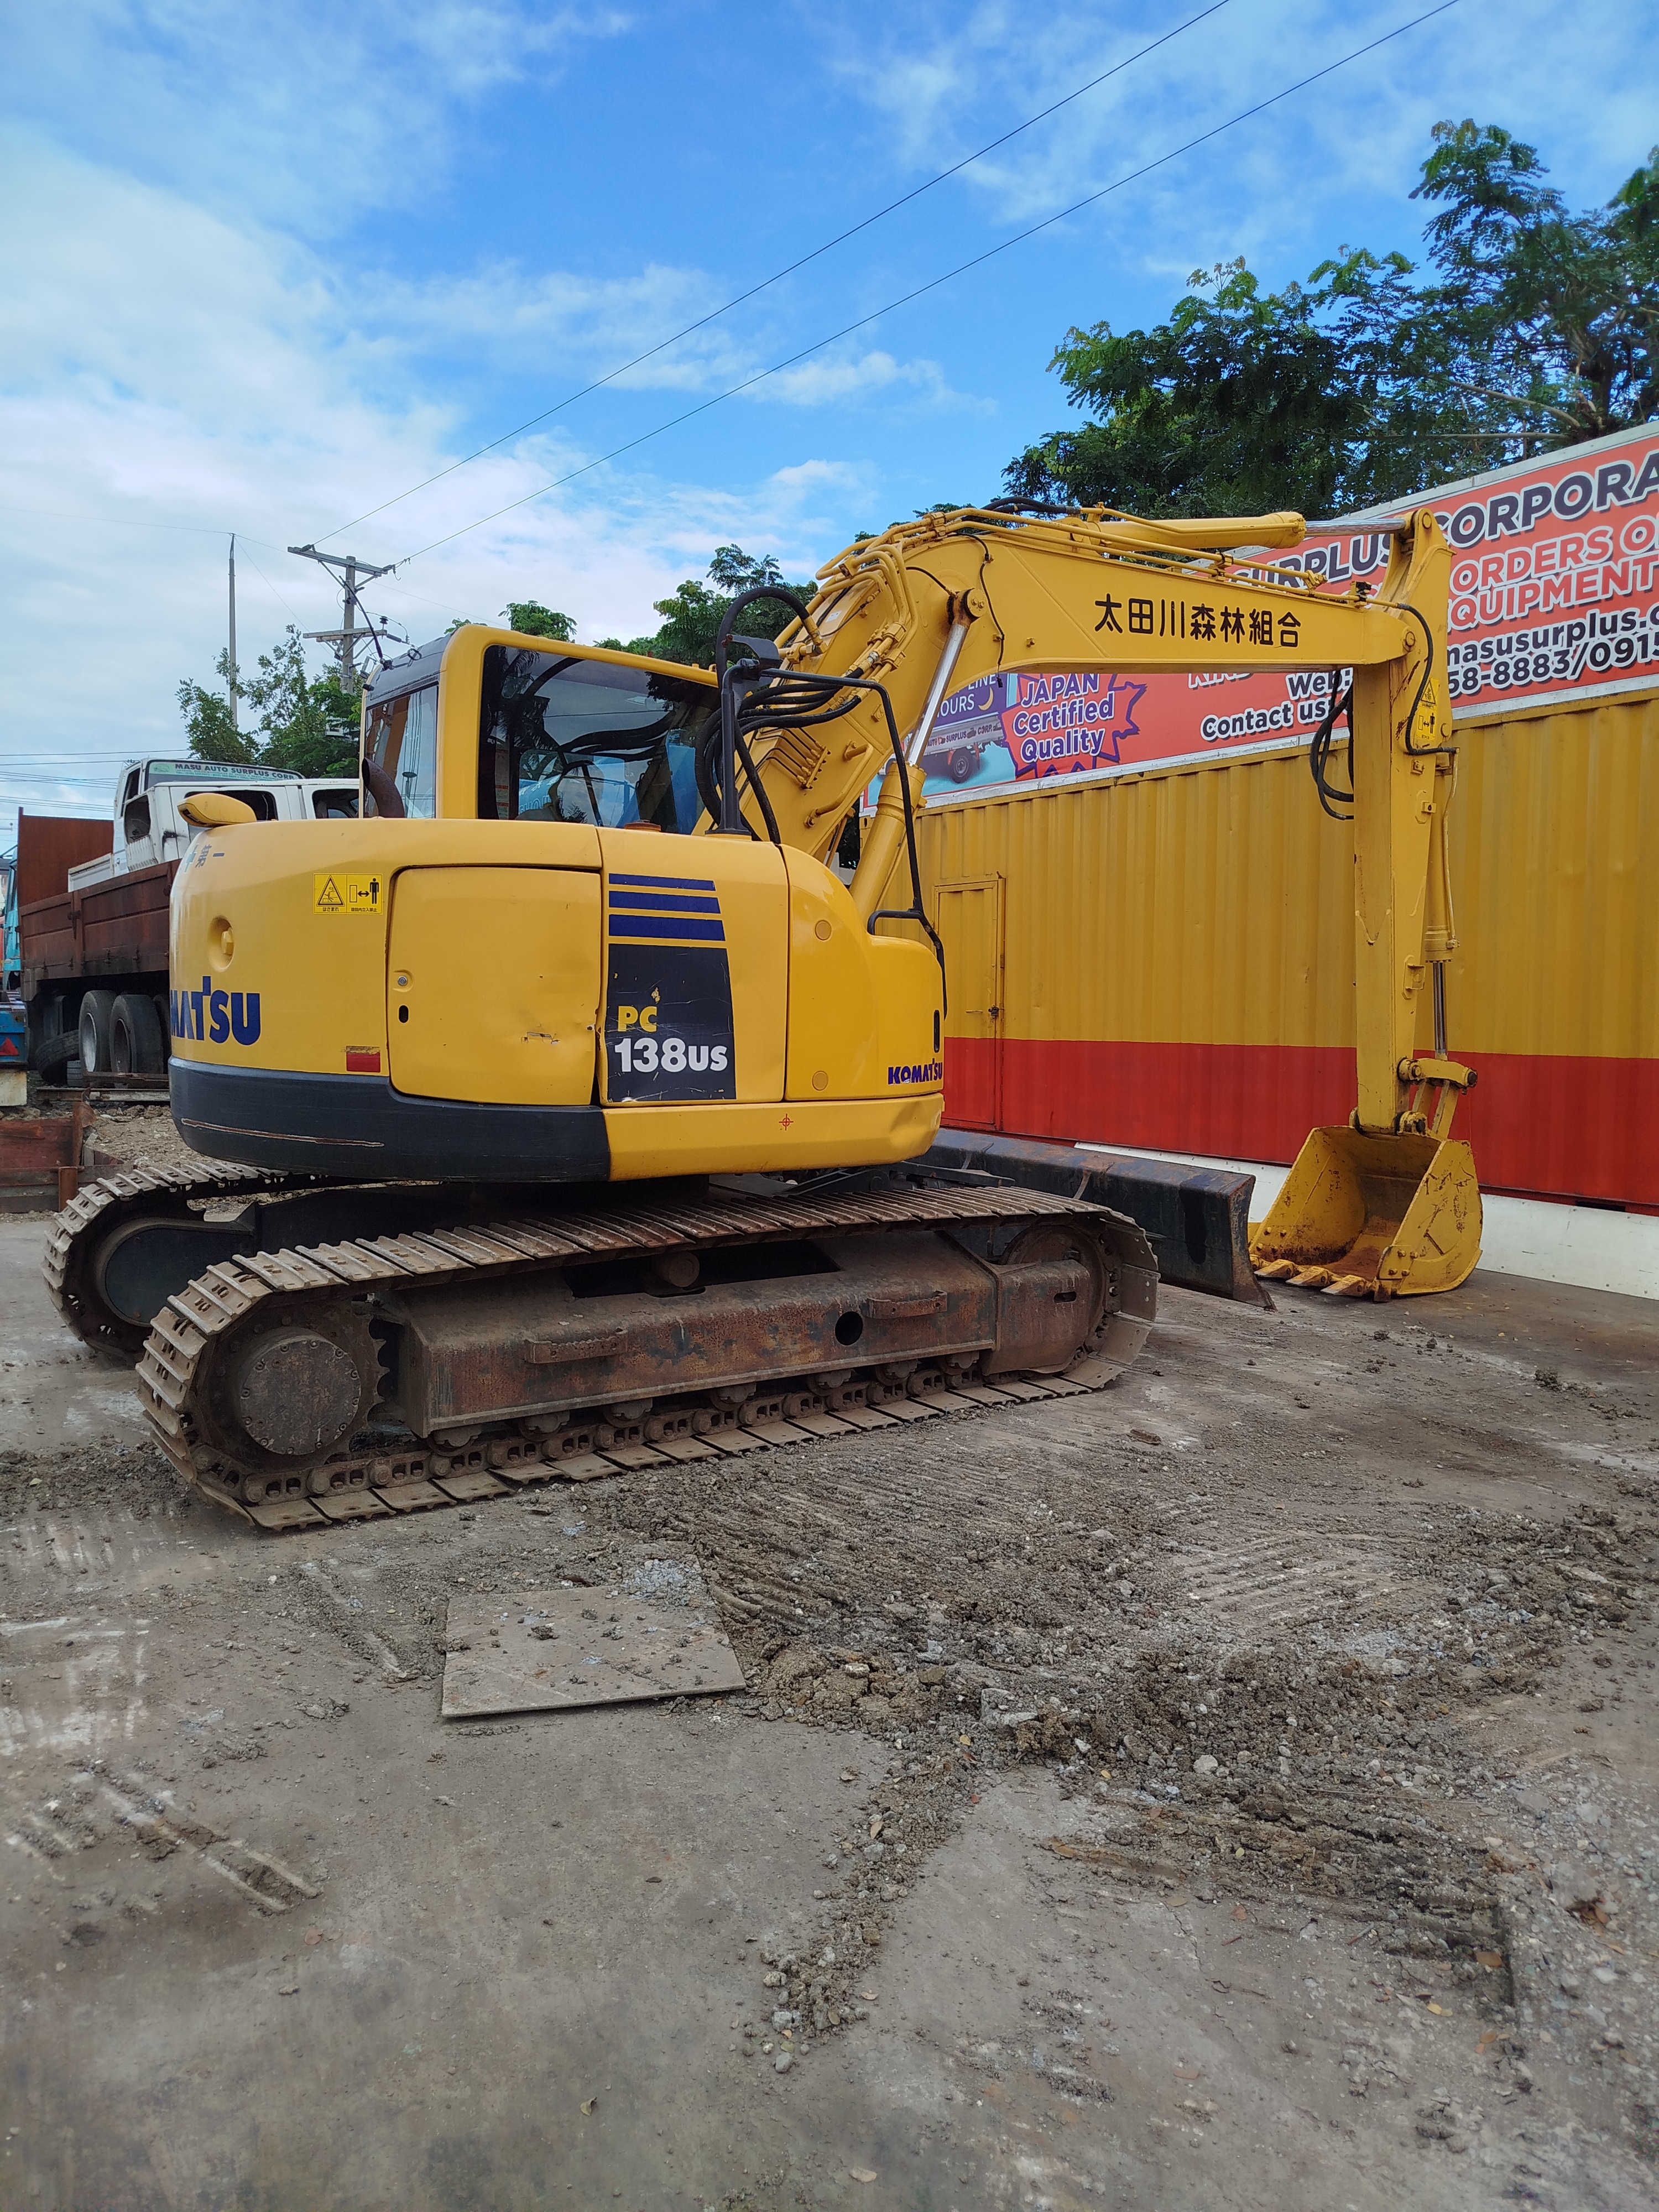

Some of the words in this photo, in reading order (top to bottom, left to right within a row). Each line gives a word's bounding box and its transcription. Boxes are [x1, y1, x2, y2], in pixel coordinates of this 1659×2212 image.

[1452, 529, 1610, 592] ORDERS
[1623, 518, 1659, 551] O
[1448, 554, 1659, 627] QUIPMENT
[1094, 593, 1301, 648] 太田川森林組合
[937, 693, 975, 718] OURS
[1022, 674, 1099, 706] JAPAN
[1014, 692, 1114, 735] Certified
[1202, 703, 1291, 738] Contact
[946, 731, 967, 743] SURPLUS
[1021, 729, 1104, 761] Quality
[231, 768, 270, 777] SURPLUS
[617, 1005, 658, 1032] PC
[888, 1057, 943, 1085] KOMATSU
